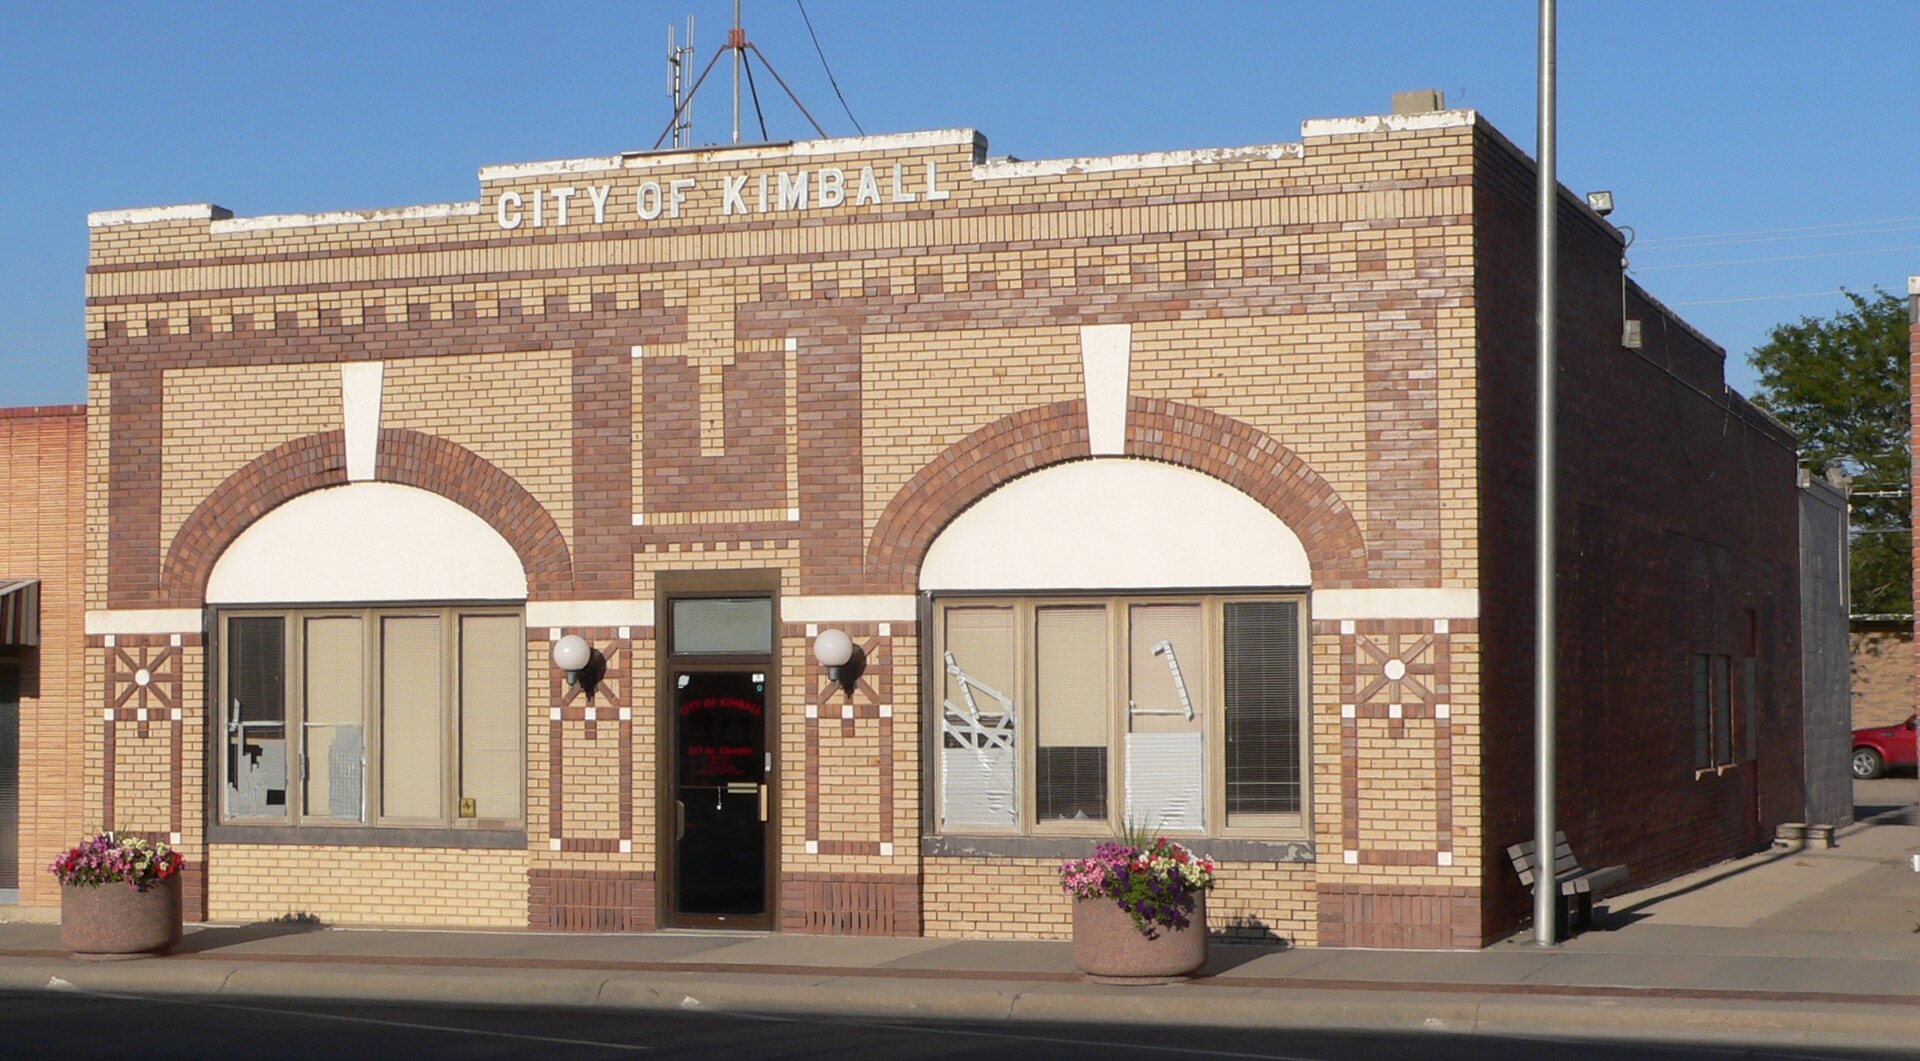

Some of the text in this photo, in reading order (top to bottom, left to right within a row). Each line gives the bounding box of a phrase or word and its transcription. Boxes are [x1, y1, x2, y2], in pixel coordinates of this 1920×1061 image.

[497, 160, 950, 230] CITY OF KIMBALL
[680, 700, 701, 716] CITY
[704, 698, 716, 708] OF
